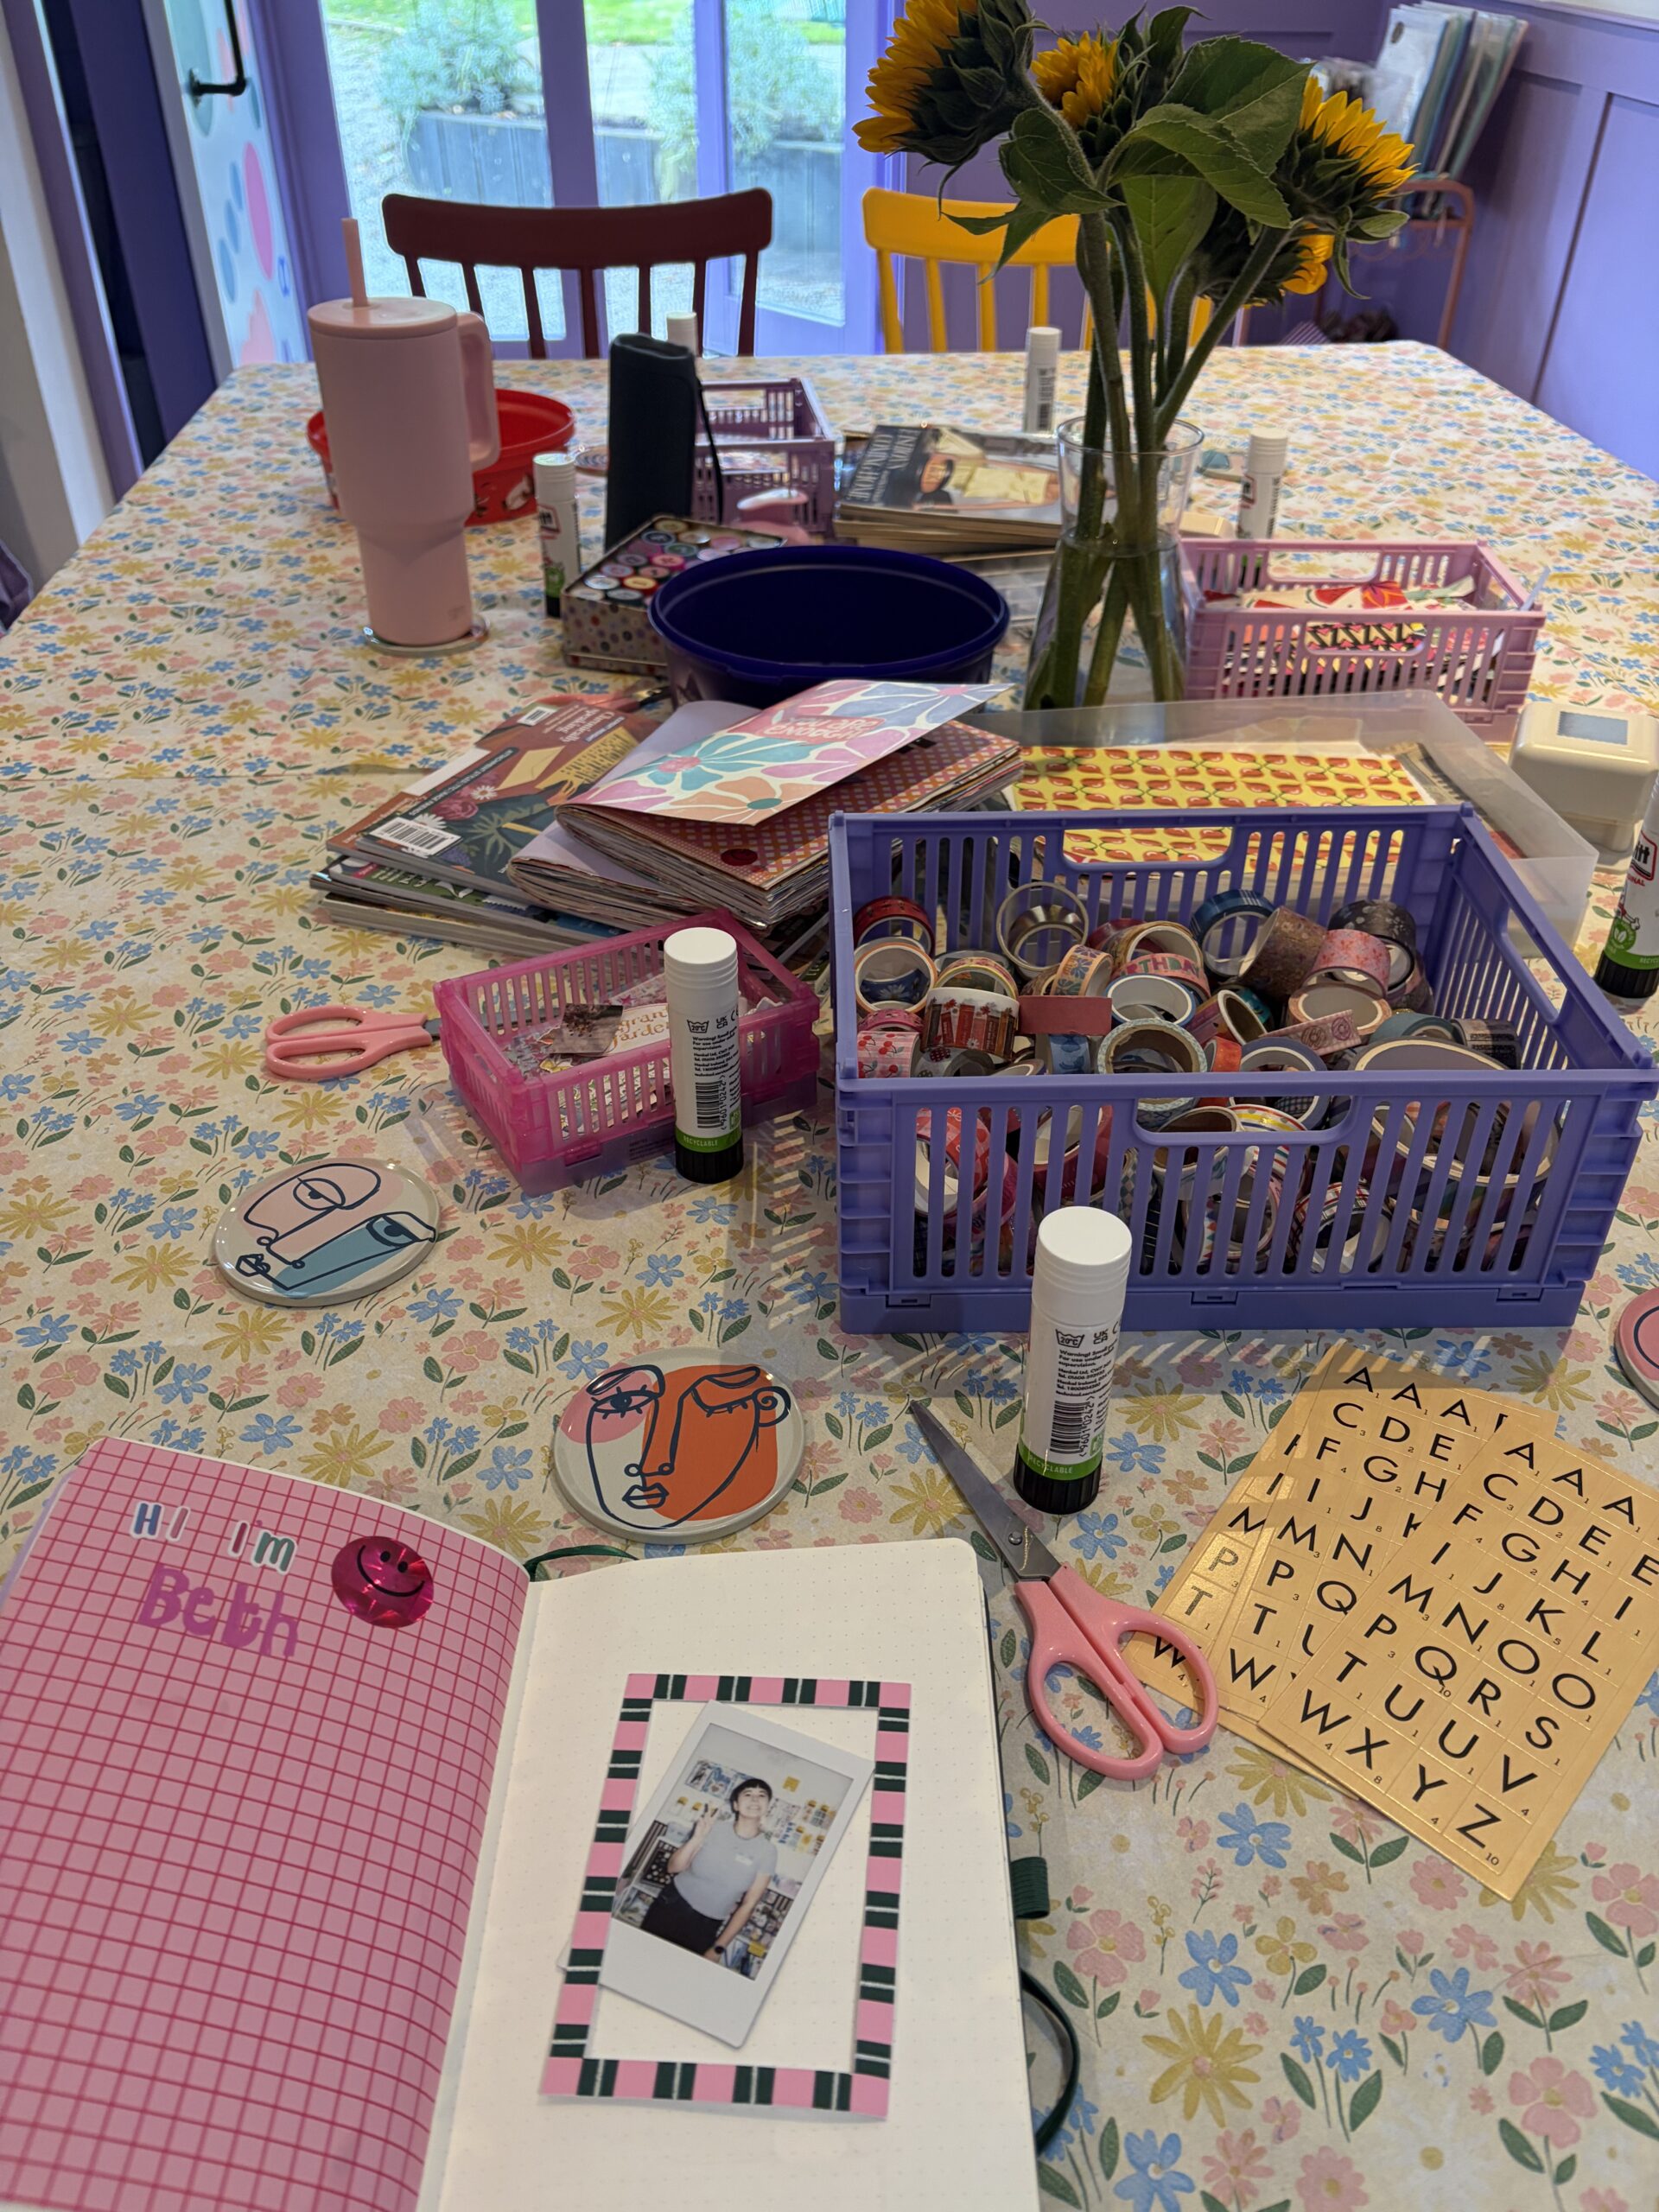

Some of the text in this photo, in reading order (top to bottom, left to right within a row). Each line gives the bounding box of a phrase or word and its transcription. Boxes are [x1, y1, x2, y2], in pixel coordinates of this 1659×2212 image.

[618, 1006, 669, 1034] gran
[1059, 1336, 1078, 1346] 20°C
[1093, 1328, 1109, 1338] UK
[1343, 1366, 1373, 1393] A
[1391, 1382, 1421, 1409] A
[1440, 1399, 1471, 1426] A
[1333, 1402, 1454, 1461] C D E
[1316, 1437, 1340, 1459] F
[1363, 1456, 1398, 1482] G
[1414, 1471, 1446, 1503] H
[1503, 1442, 1634, 1525] A A A
[1350, 1497, 1373, 1520] J
[1484, 1474, 1659, 1586] C D E E
[1209, 1547, 1238, 1571] P
[1277, 1516, 1372, 1571] M N
[1452, 1503, 1484, 1525] F
[1502, 1533, 1540, 1562] G
[1550, 1559, 1591, 1595] H
[138, 1561, 300, 1657] Beth
[1185, 1586, 1212, 1616] T
[1267, 1560, 1357, 1616] P Q
[1473, 1573, 1503, 1593] J
[1525, 1599, 1566, 1636] K
[1581, 1631, 1601, 1662] L
[1253, 1604, 1277, 1635] T
[1388, 1574, 1596, 1709] M N O O
[1230, 1648, 1276, 1690] W
[1364, 1613, 1560, 1749] P Q R S
[1337, 1651, 1538, 1793] T U U V
[1300, 1689, 1501, 1848] W X Y Z
